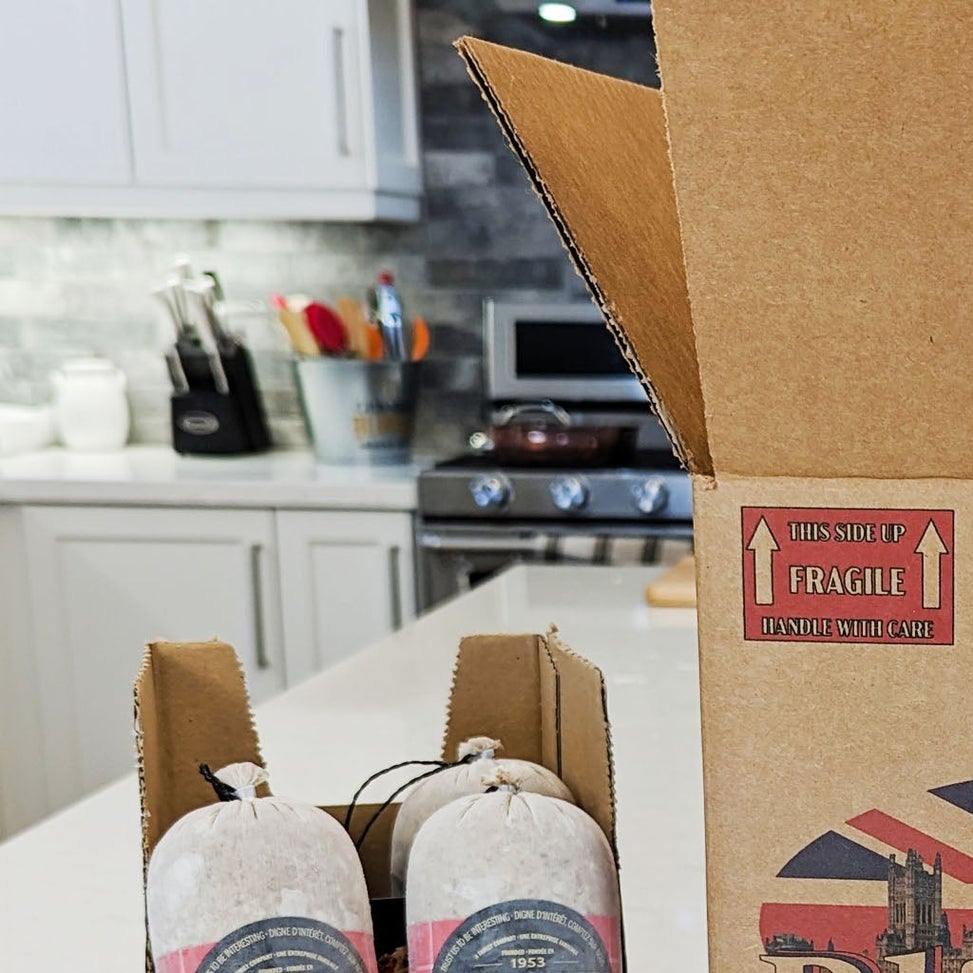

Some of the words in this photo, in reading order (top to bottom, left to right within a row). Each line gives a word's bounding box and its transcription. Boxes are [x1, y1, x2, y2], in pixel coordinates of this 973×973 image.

[788, 521, 830, 541] THIS
[835, 522, 876, 542] SIDE
[880, 523, 906, 543] UP
[788, 564, 906, 596] FRAGILE
[761, 616, 832, 637] HANDLE
[836, 618, 882, 637] WITH
[886, 619, 935, 639] CARE
[211, 961, 220, 972] TO
[216, 953, 228, 965] BE
[223, 931, 266, 958] INTERESTING
[269, 926, 291, 938] DIGNE
[440, 952, 454, 972] TRUST
[450, 944, 460, 955] US
[456, 937, 465, 948] TO
[462, 930, 473, 942] BE
[470, 912, 511, 936] INTERESTING
[514, 910, 535, 920] DIGNE
[511, 956, 546, 969] 1953
